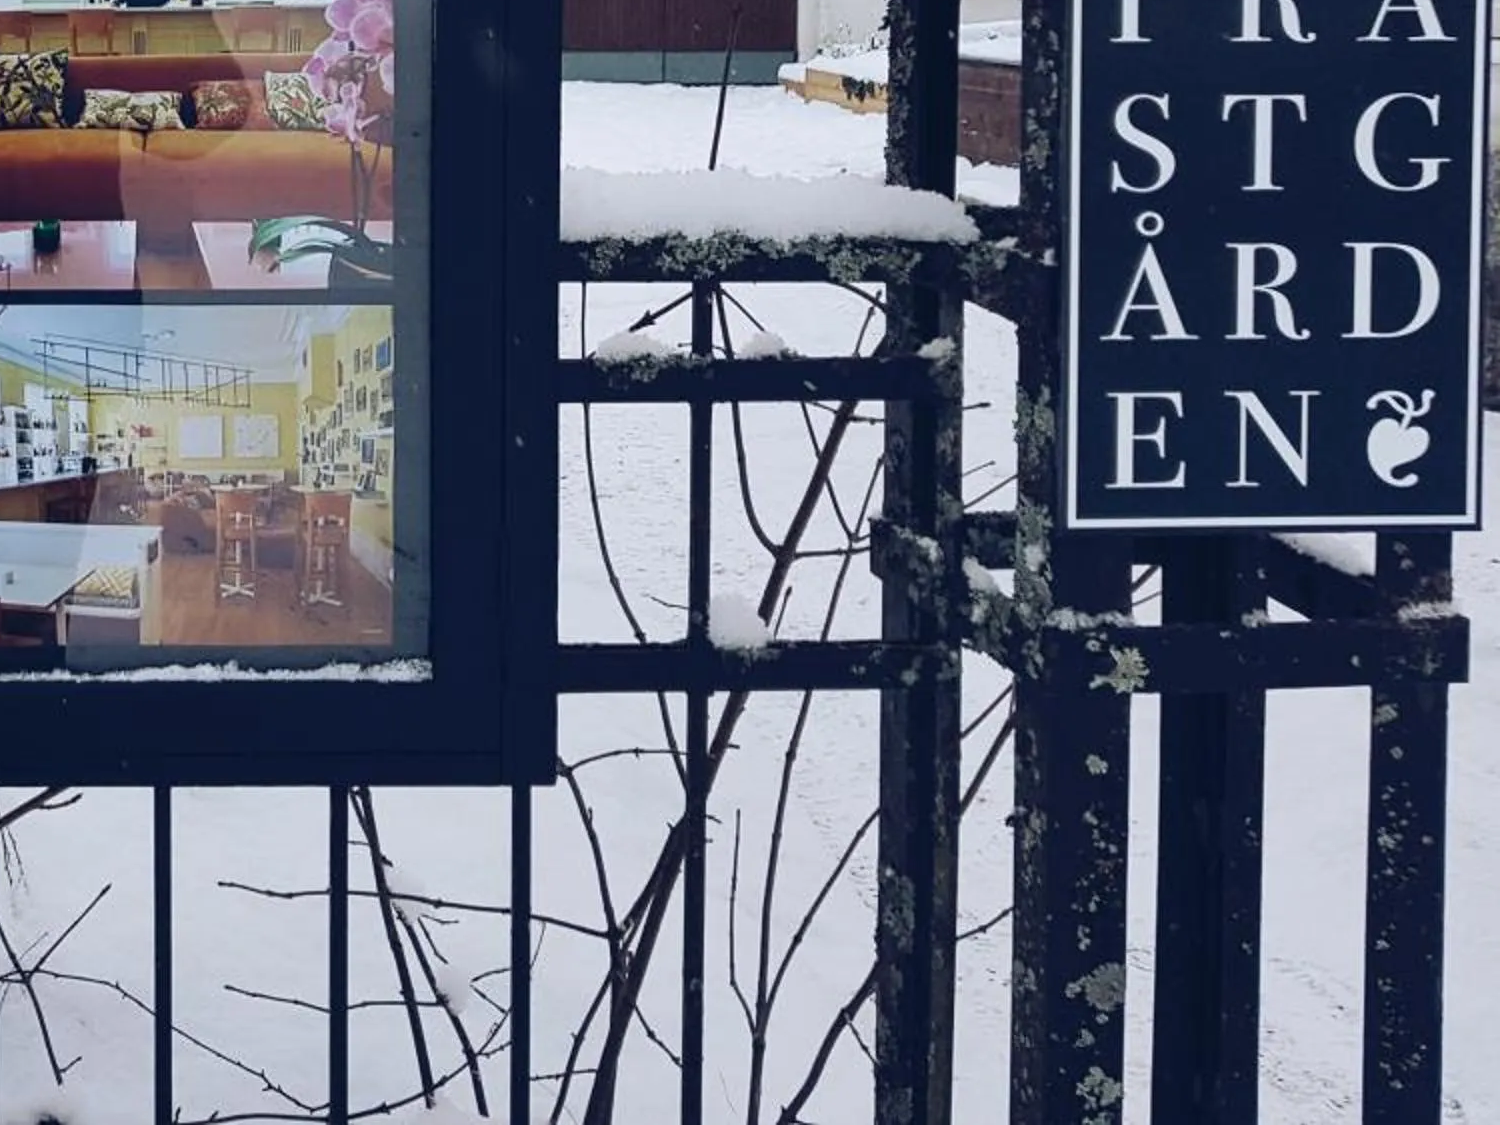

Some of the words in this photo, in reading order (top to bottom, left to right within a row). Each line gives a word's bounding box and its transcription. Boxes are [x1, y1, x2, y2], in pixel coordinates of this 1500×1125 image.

[1110, 91, 1452, 193] STG
[1099, 210, 1441, 341] ÅRD
[1104, 389, 1321, 489] EN
